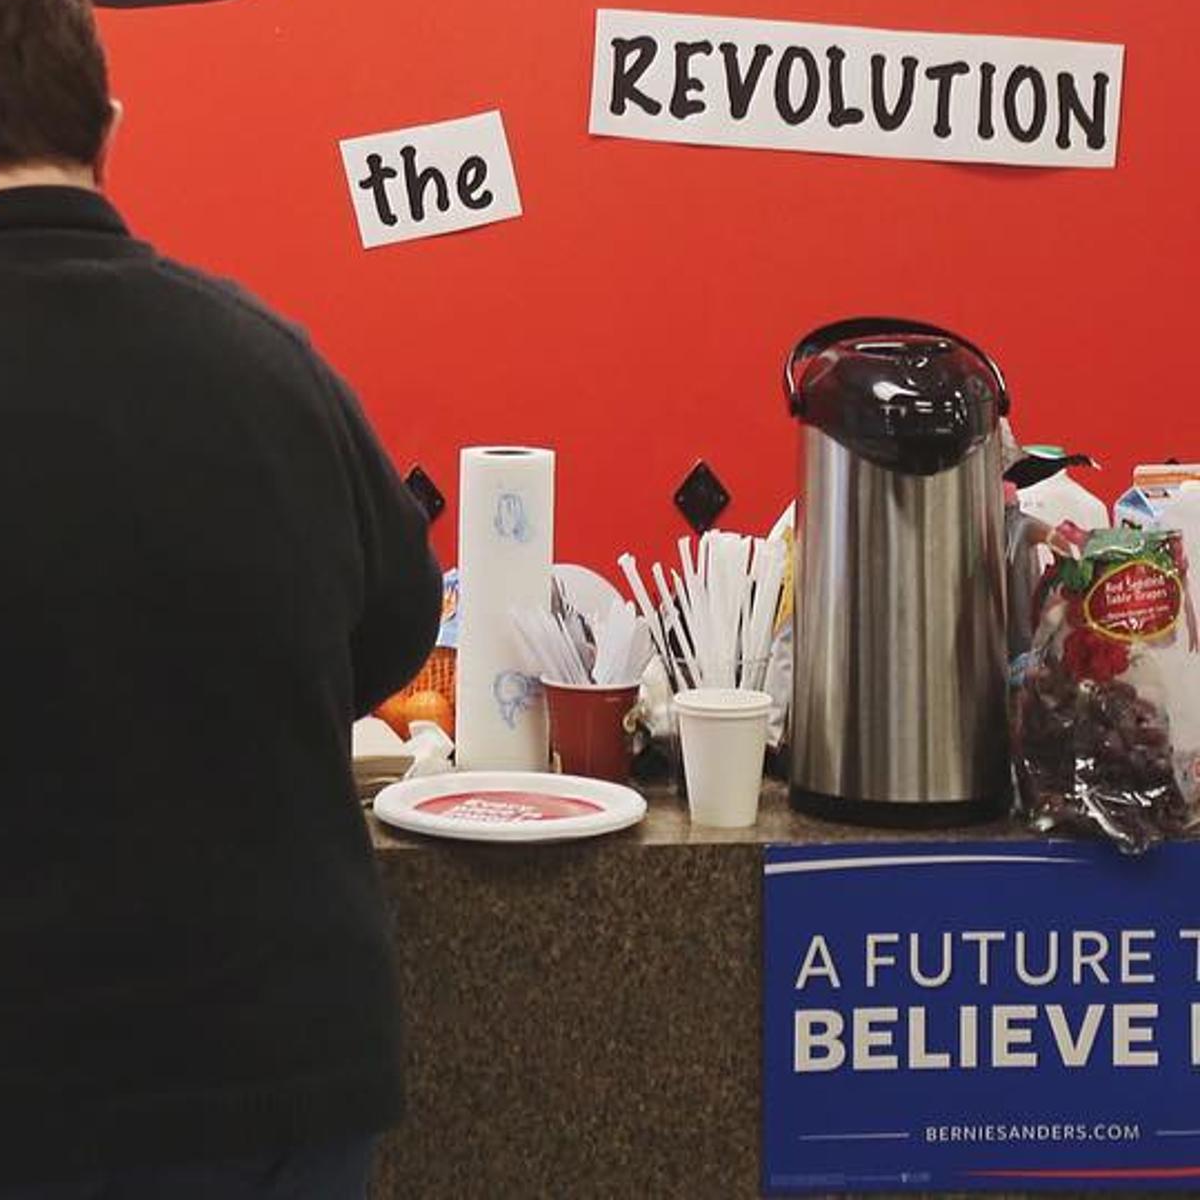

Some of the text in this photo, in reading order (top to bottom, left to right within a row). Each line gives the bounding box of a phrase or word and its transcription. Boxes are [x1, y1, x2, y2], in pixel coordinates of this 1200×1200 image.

[610, 36, 1109, 151] REVOLUTION
[359, 145, 493, 227] the
[795, 934, 841, 990] A
[866, 930, 1157, 988] FUTURE
[794, 1003, 1160, 1073] BELIEVE
[925, 1123, 1141, 1143] BERNIESANDERS.COM
